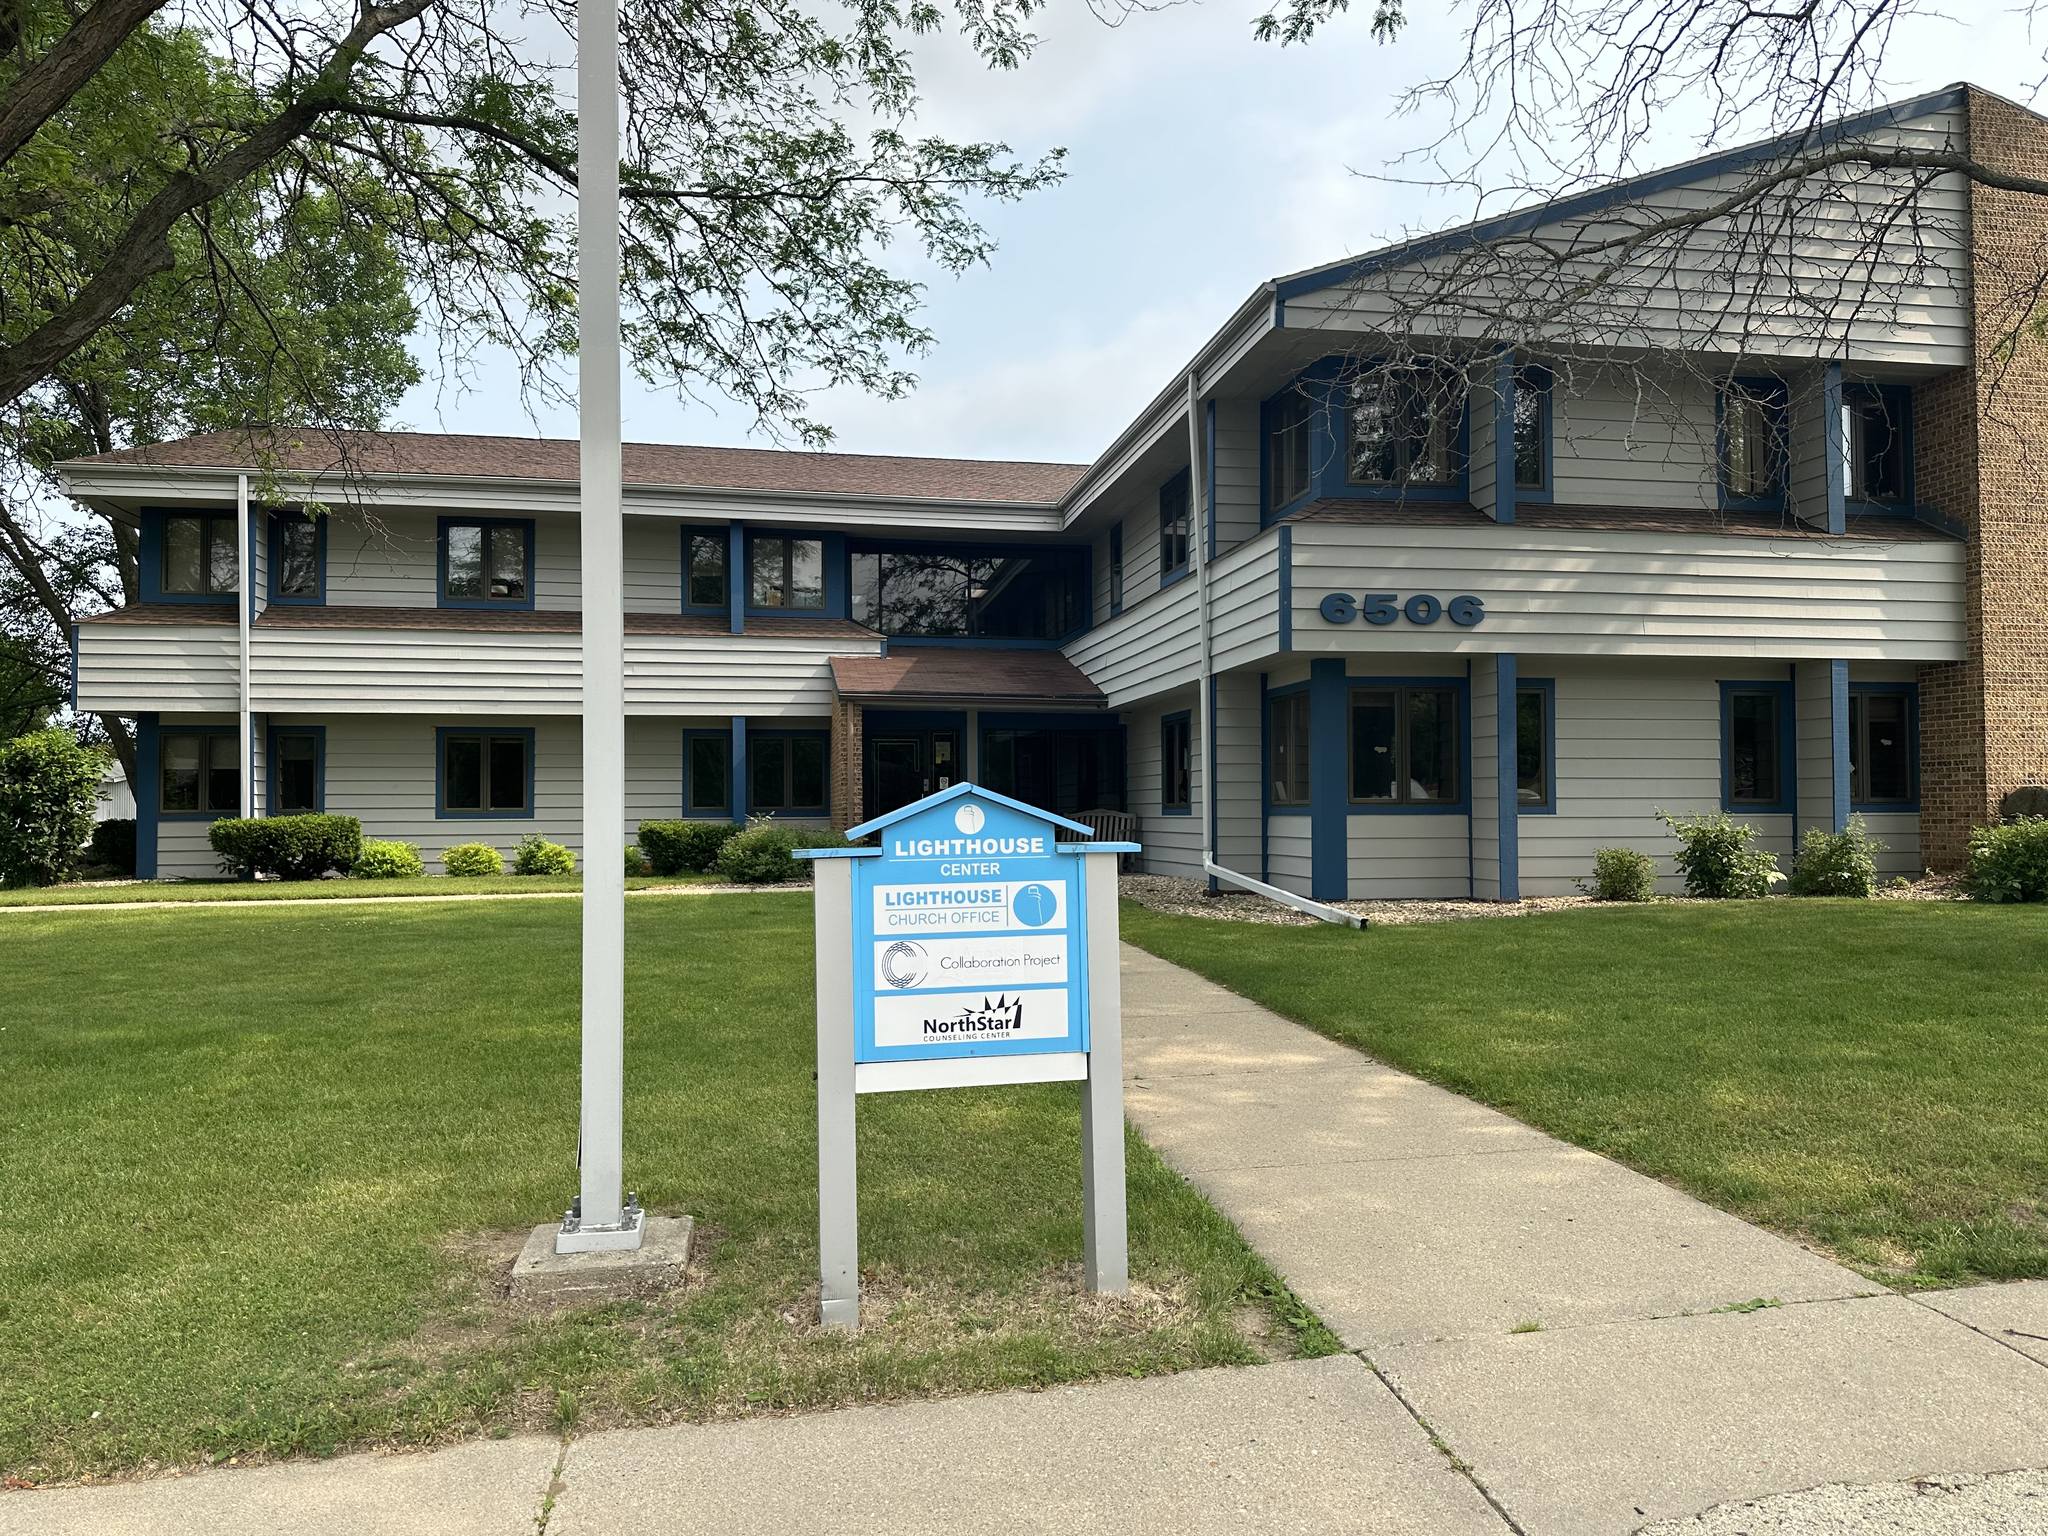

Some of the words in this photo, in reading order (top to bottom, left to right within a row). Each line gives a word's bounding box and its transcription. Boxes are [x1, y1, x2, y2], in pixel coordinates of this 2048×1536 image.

[1320, 593, 1486, 626] 6506
[895, 837, 1044, 857] LIGHTHOUSE
[940, 862, 1001, 877] CENTER
[885, 889, 1002, 906] LIGHTHOUSE
[888, 912, 947, 927] CHURCH
[951, 910, 1000, 924] OFFICE
[940, 955, 1021, 970] Collaboration
[1023, 953, 1061, 969] Project
[923, 1015, 1012, 1035] NorthStar
[923, 1032, 978, 1043] COUNSELING
[980, 1031, 1011, 1041] CENTER
